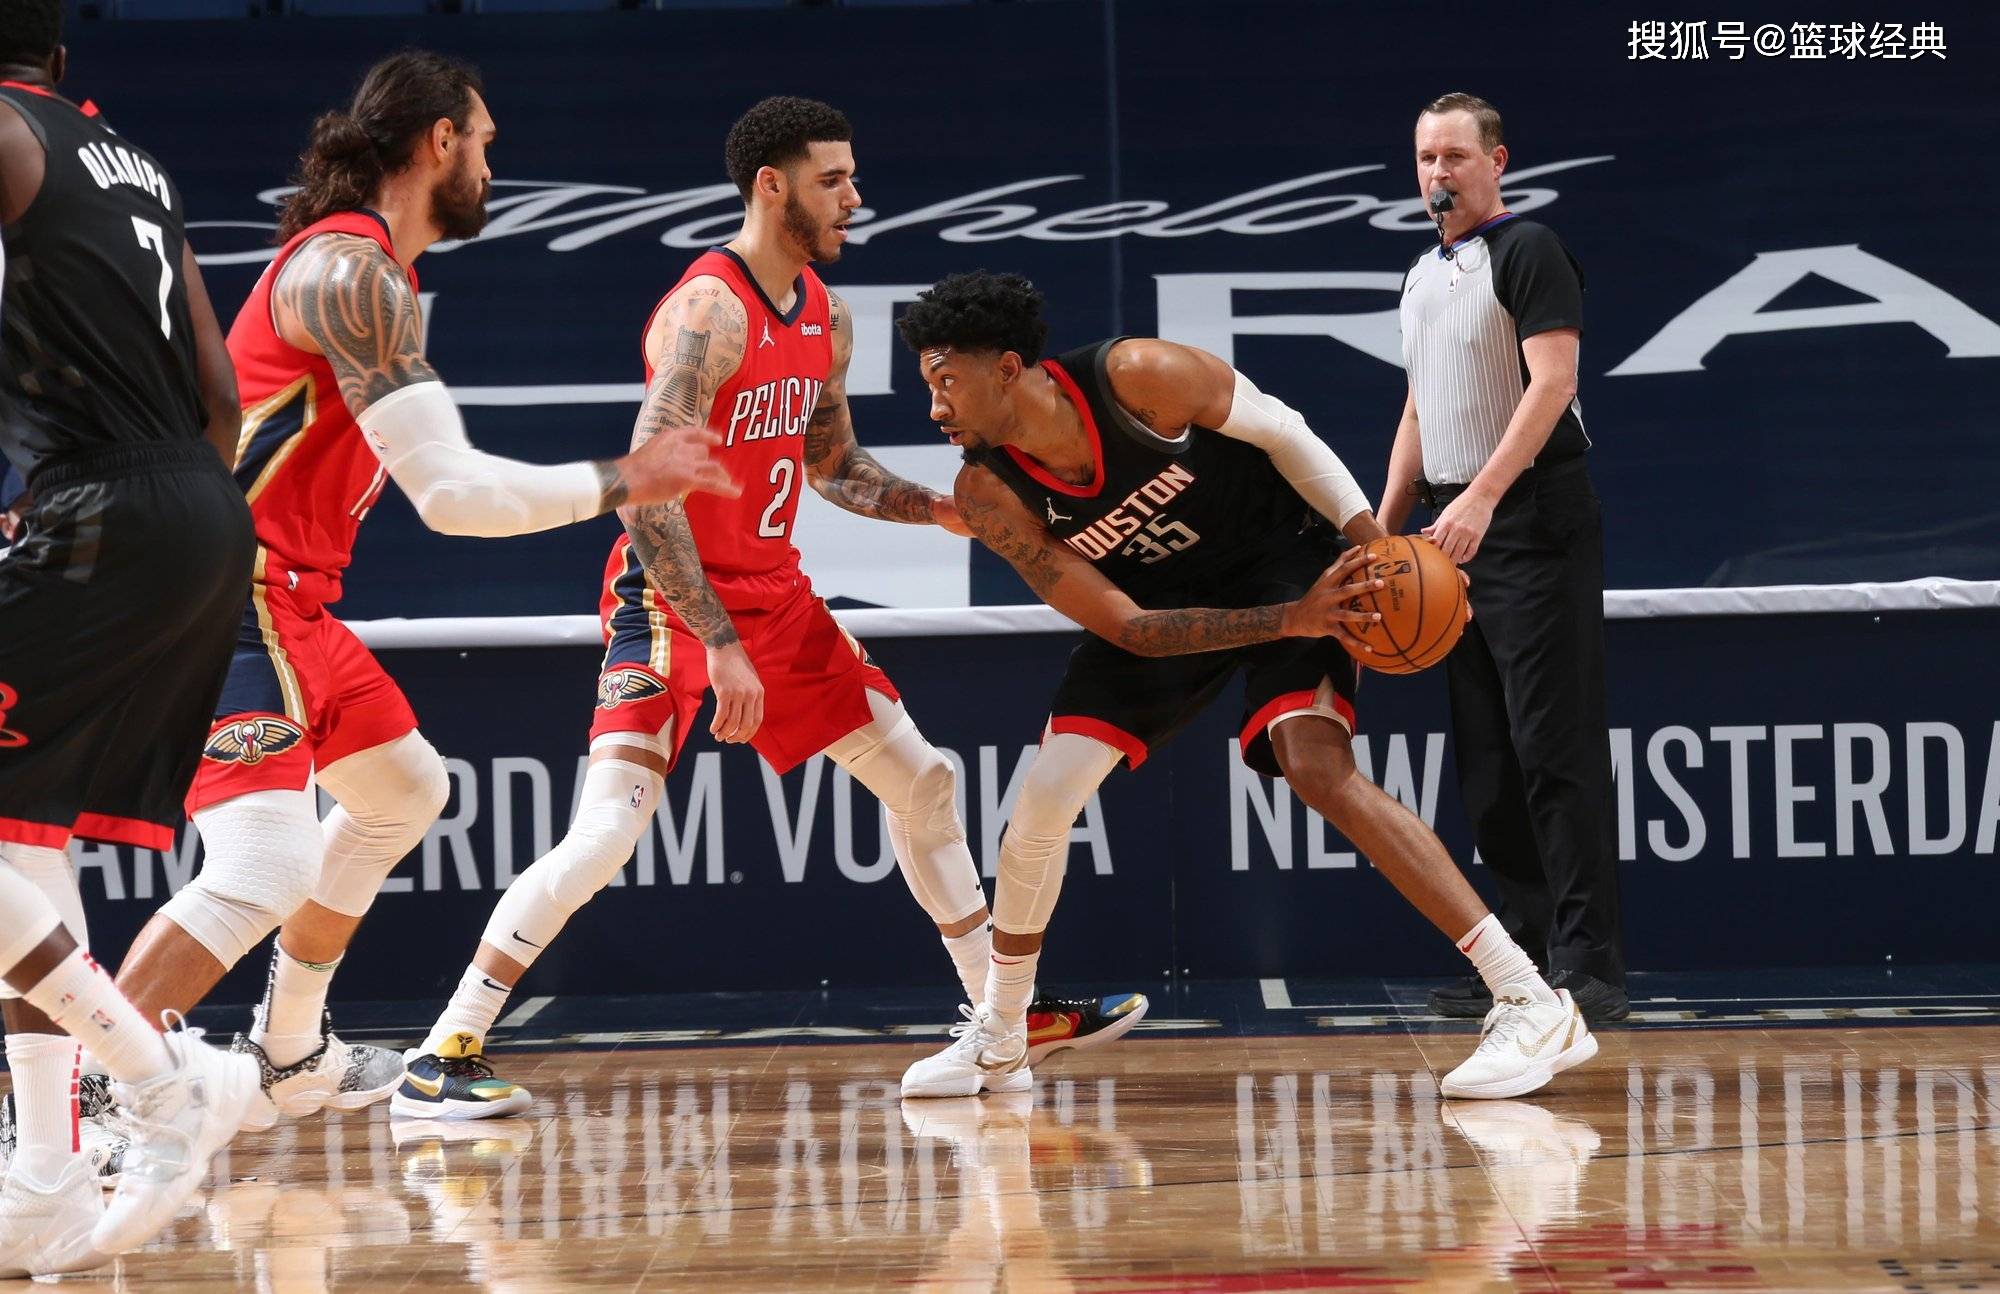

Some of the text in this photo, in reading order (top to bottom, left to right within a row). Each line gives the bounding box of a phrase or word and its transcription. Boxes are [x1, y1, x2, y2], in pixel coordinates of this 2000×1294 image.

[78, 141, 171, 211] OLADIPO
[130, 215, 173, 341] 7
[800, 322, 822, 336] ibotta
[758, 457, 796, 538] 2
[1064, 463, 1196, 561] OUSTON
[1121, 513, 1201, 565] 35
